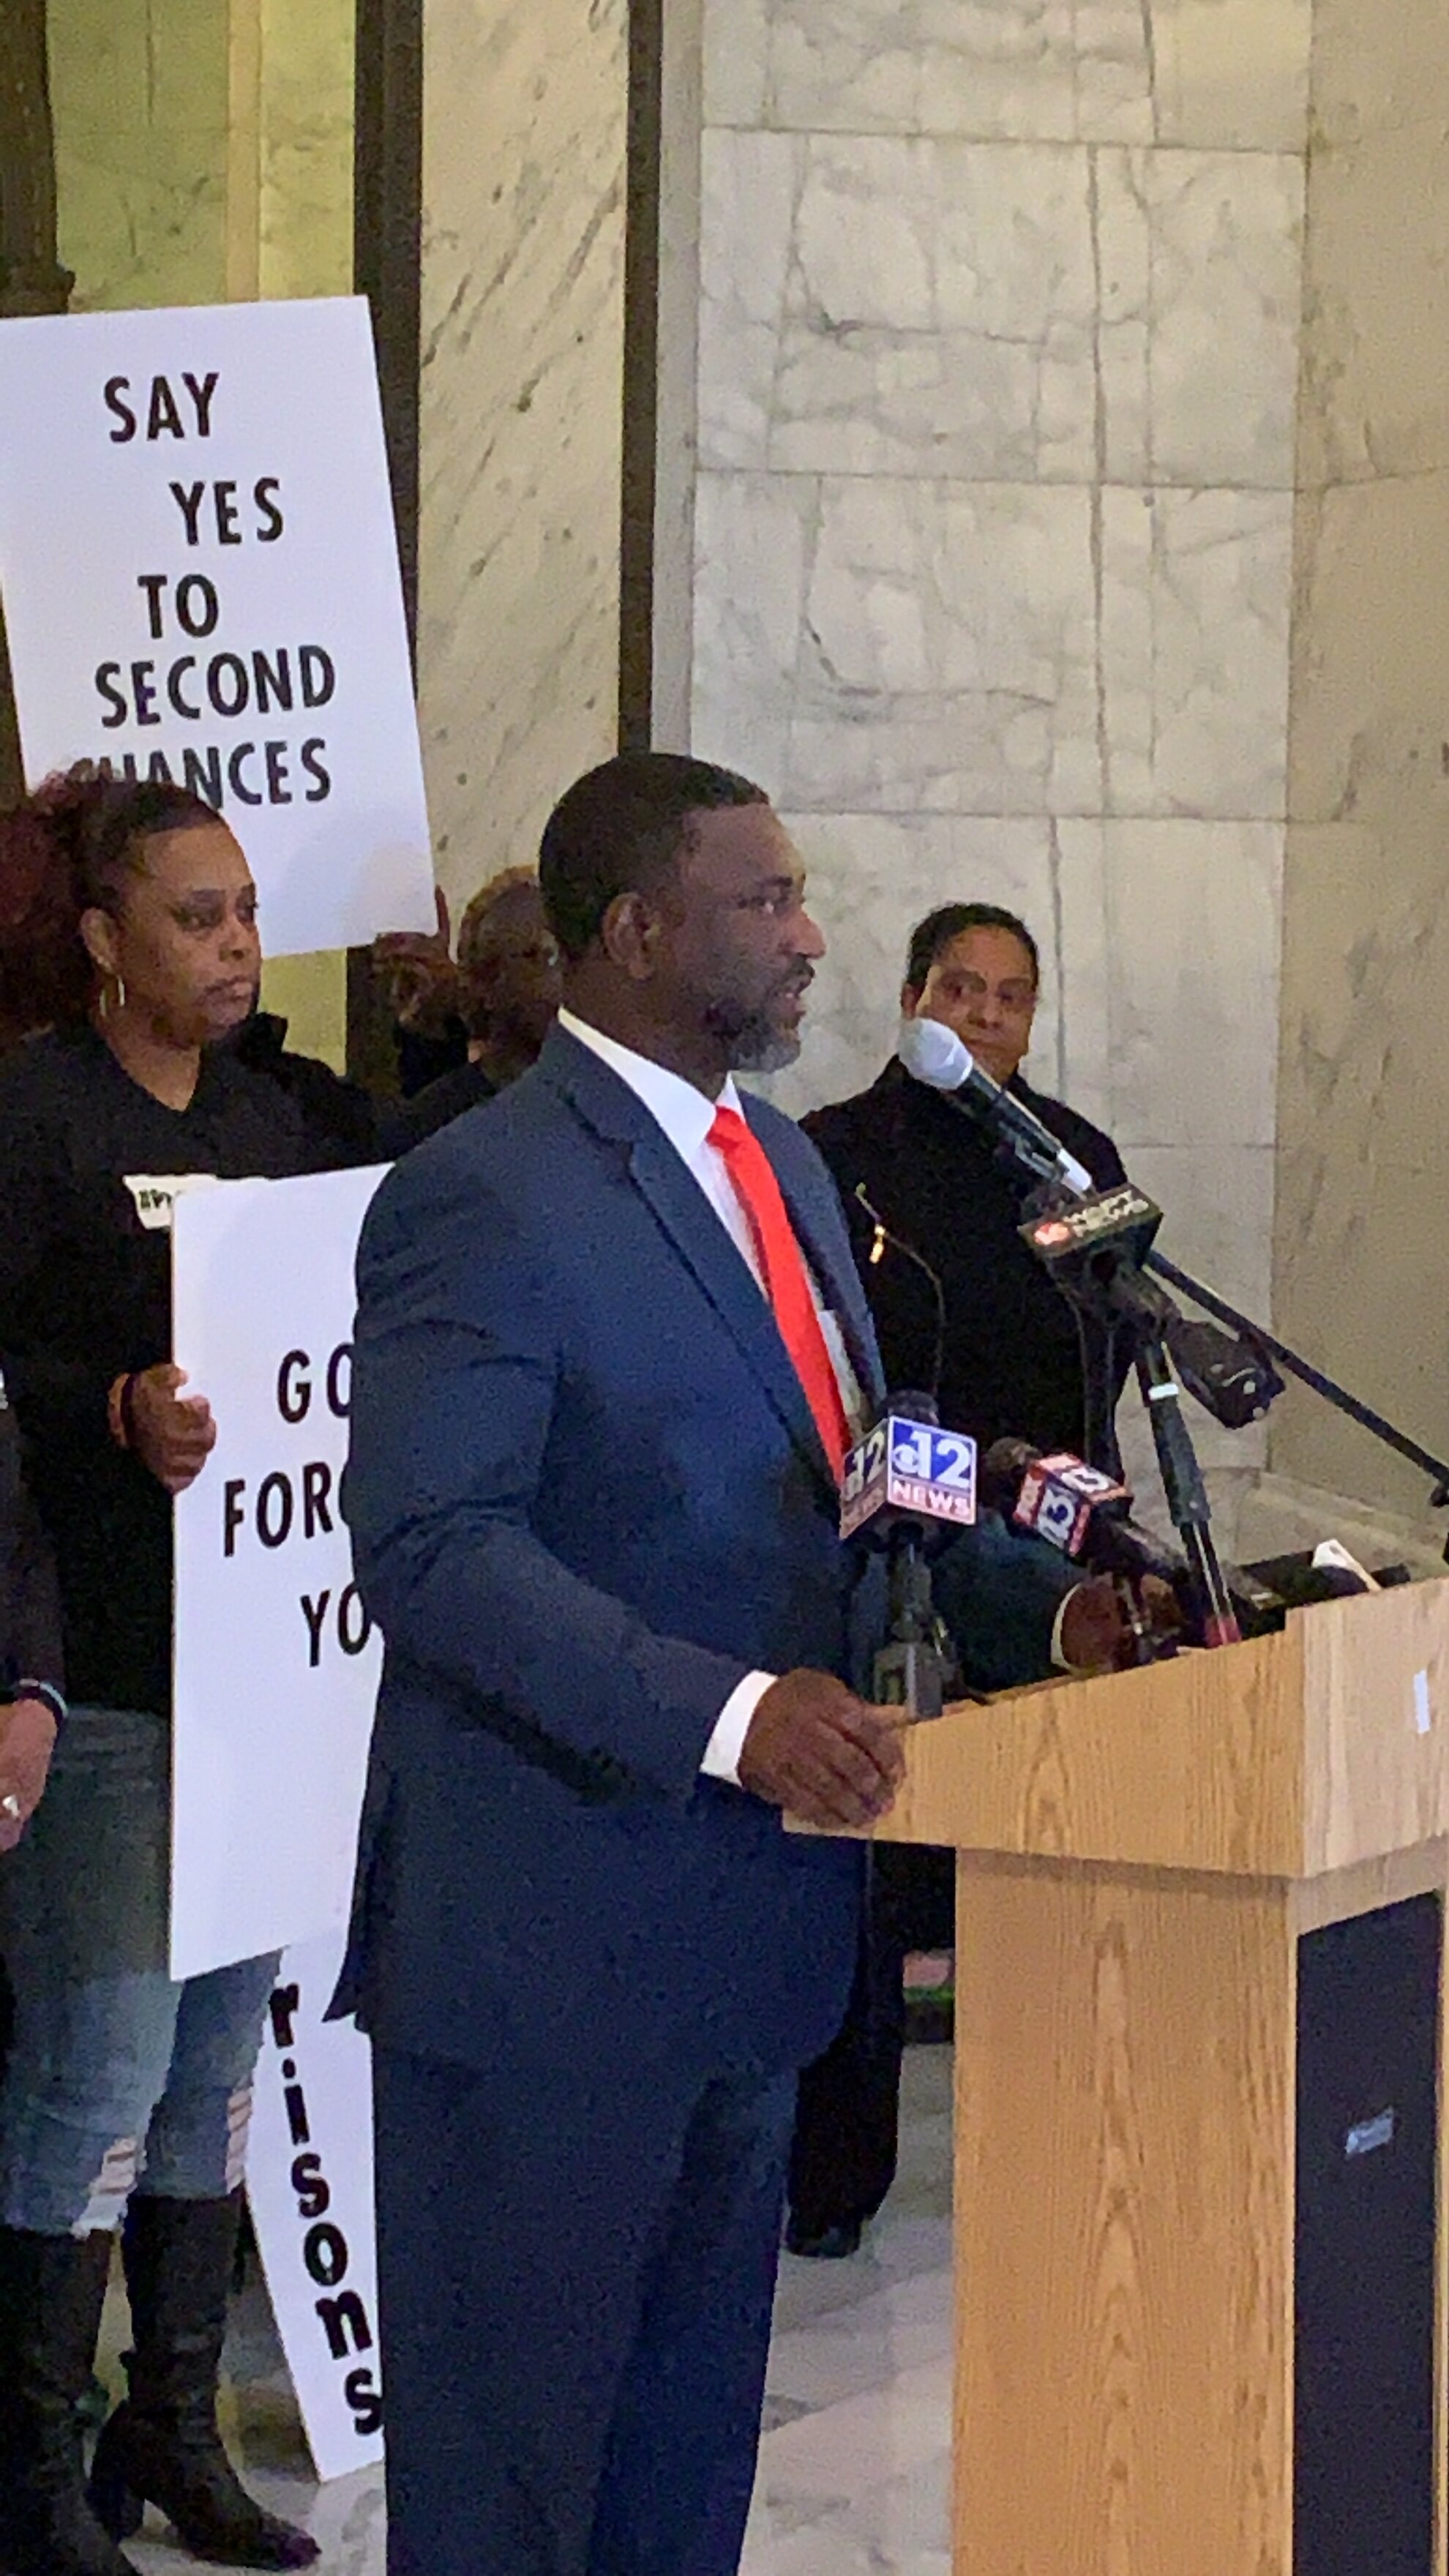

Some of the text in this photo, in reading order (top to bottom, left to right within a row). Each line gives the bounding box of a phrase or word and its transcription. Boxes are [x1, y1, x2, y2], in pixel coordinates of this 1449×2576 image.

[104, 372, 220, 442] SAY
[168, 477, 285, 546] YES
[137, 574, 220, 639] TO
[95, 645, 335, 728] SECOND
[892, 1479, 970, 1516] NEWS
